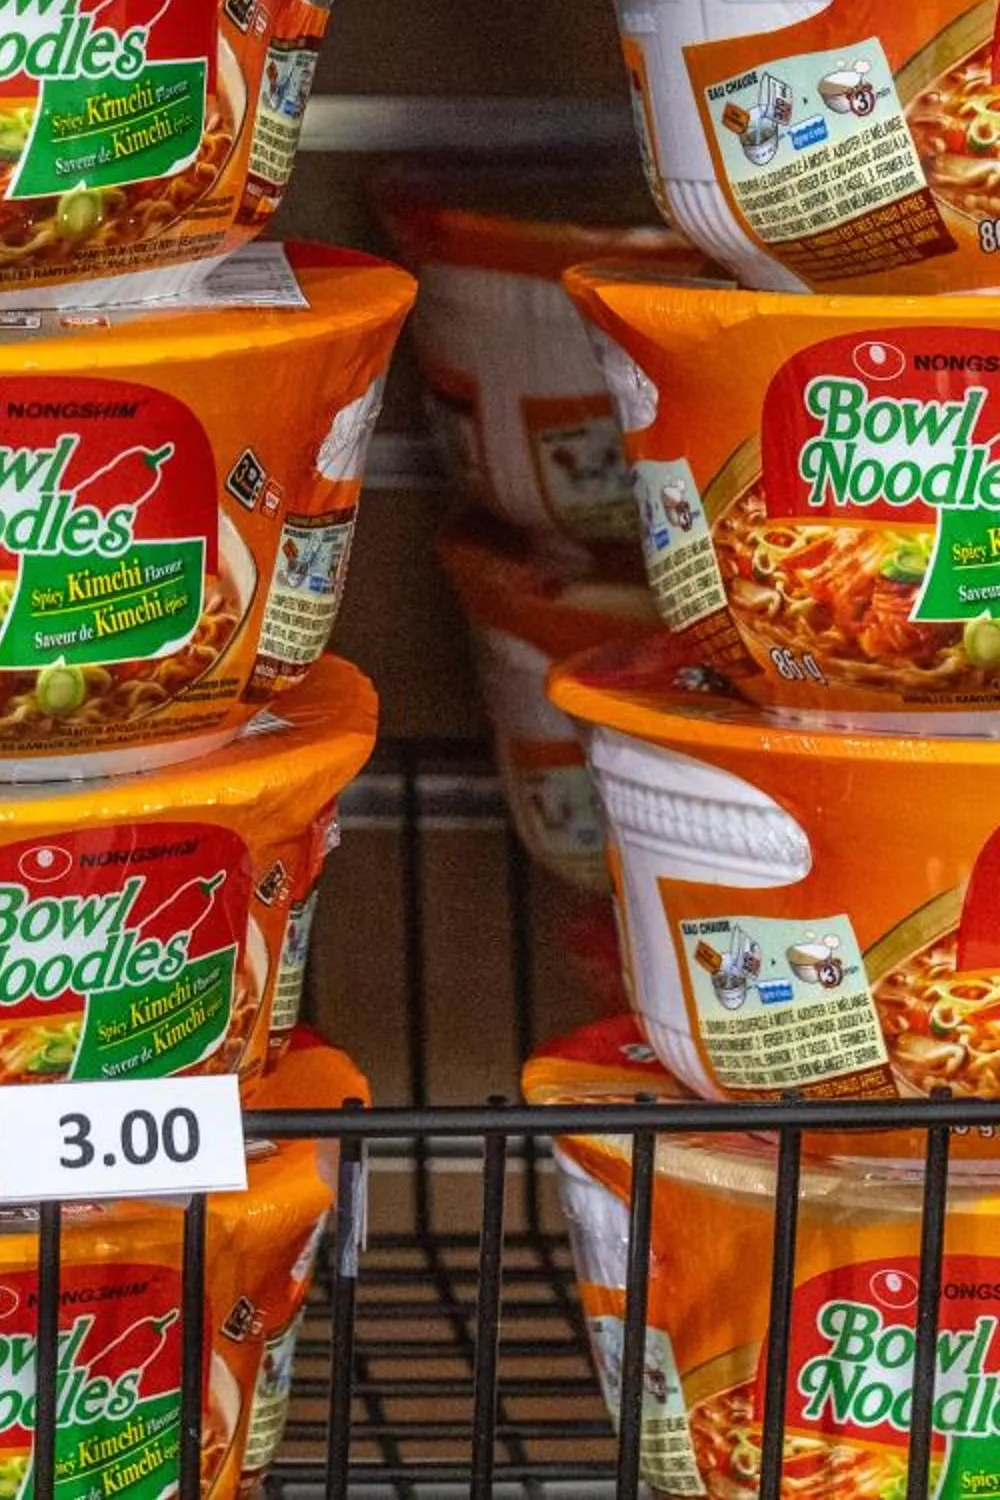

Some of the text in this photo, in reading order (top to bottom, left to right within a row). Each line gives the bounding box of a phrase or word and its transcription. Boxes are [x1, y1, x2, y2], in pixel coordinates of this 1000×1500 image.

[51, 114, 84, 136] Spicy
[87, 80, 153, 125] Kimchi
[55, 121, 173, 175] Saveur de Kimchi
[7, 402, 137, 419] NONGSHIM
[806, 376, 989, 448] Bowl
[799, 439, 1000, 508] Noodle
[952, 542, 987, 561] Spicy
[31, 559, 184, 609] Spicy Kimchi Flavour
[35, 594, 163, 649] Saveur de Kimchi
[770, 646, 799, 679] 86
[79, 841, 199, 868] NONGSHIM
[98, 978, 192, 1041] Spicy Kimchi
[101, 1003, 206, 1078] Saveur de Kimchi
[58, 1106, 201, 1170] 3.00
[78, 1416, 145, 1470] Kimchi
[102, 1443, 164, 1498] Kimchi
